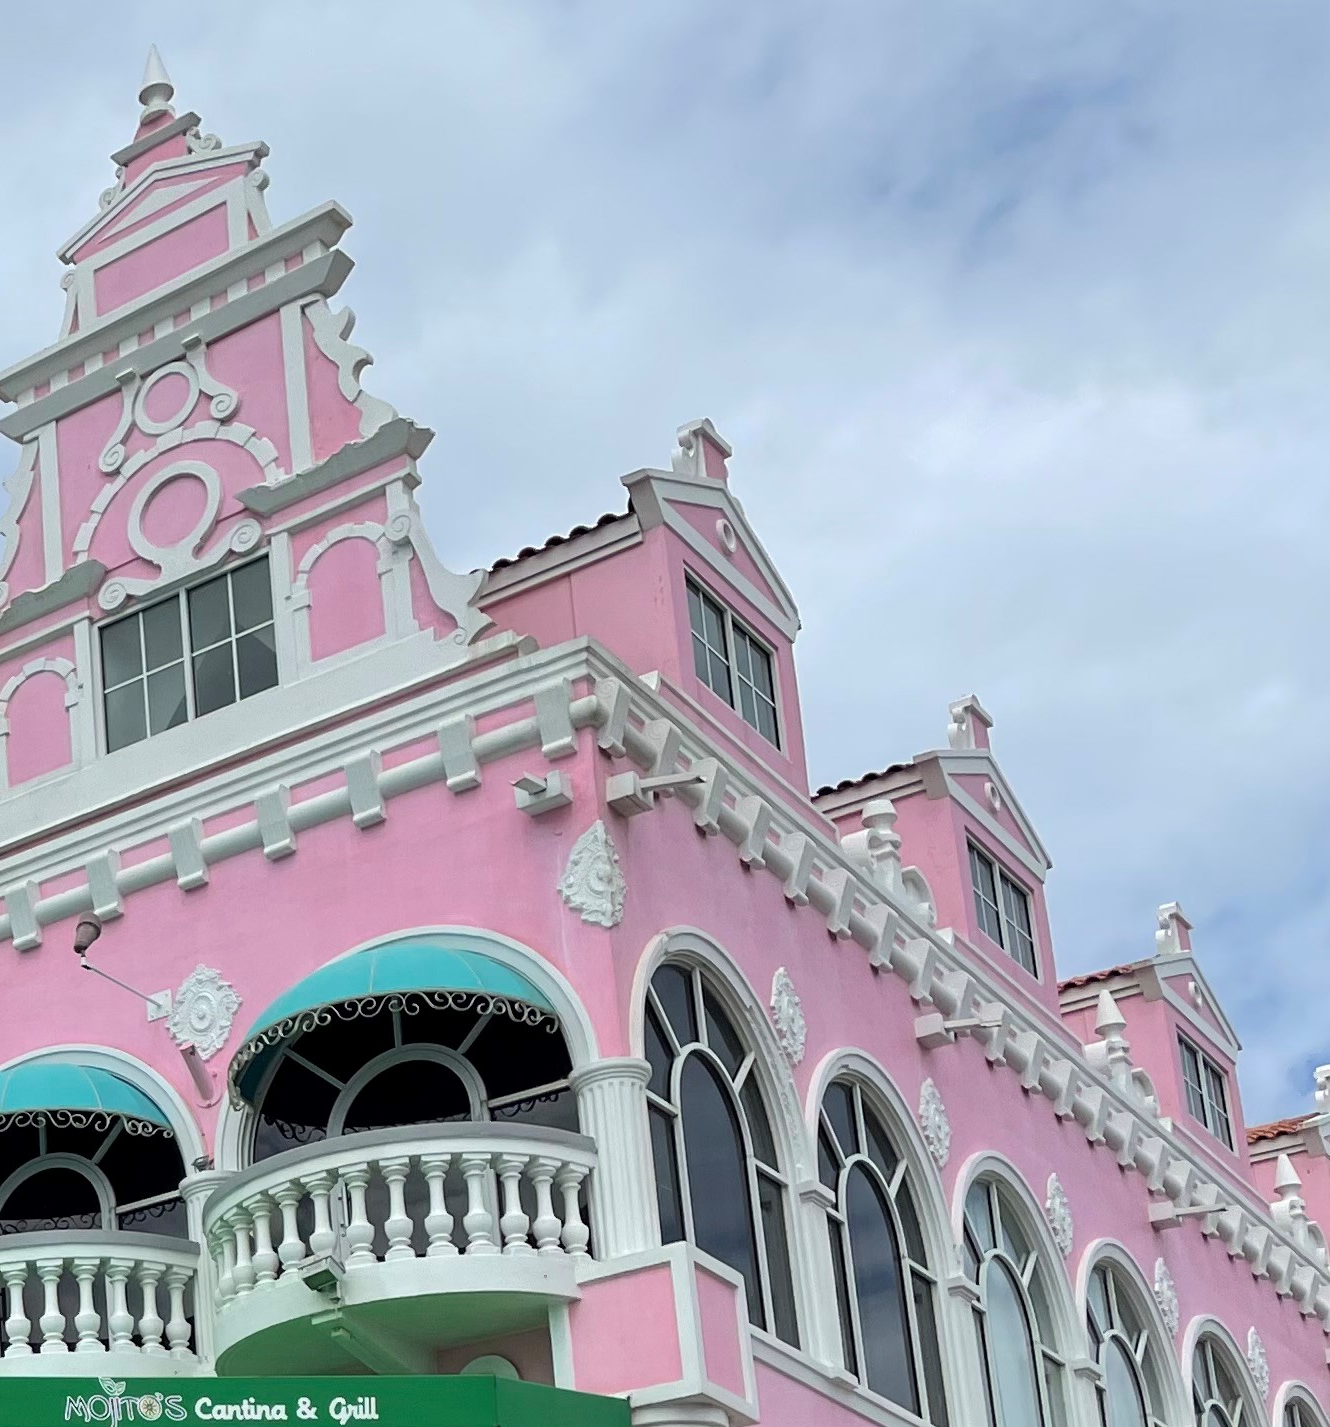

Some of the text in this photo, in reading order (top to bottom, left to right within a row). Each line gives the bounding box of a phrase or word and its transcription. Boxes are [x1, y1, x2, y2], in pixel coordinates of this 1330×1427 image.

[194, 1396, 288, 1421] Cantina
[295, 1396, 319, 1420] &
[328, 1396, 379, 1425] Grill
